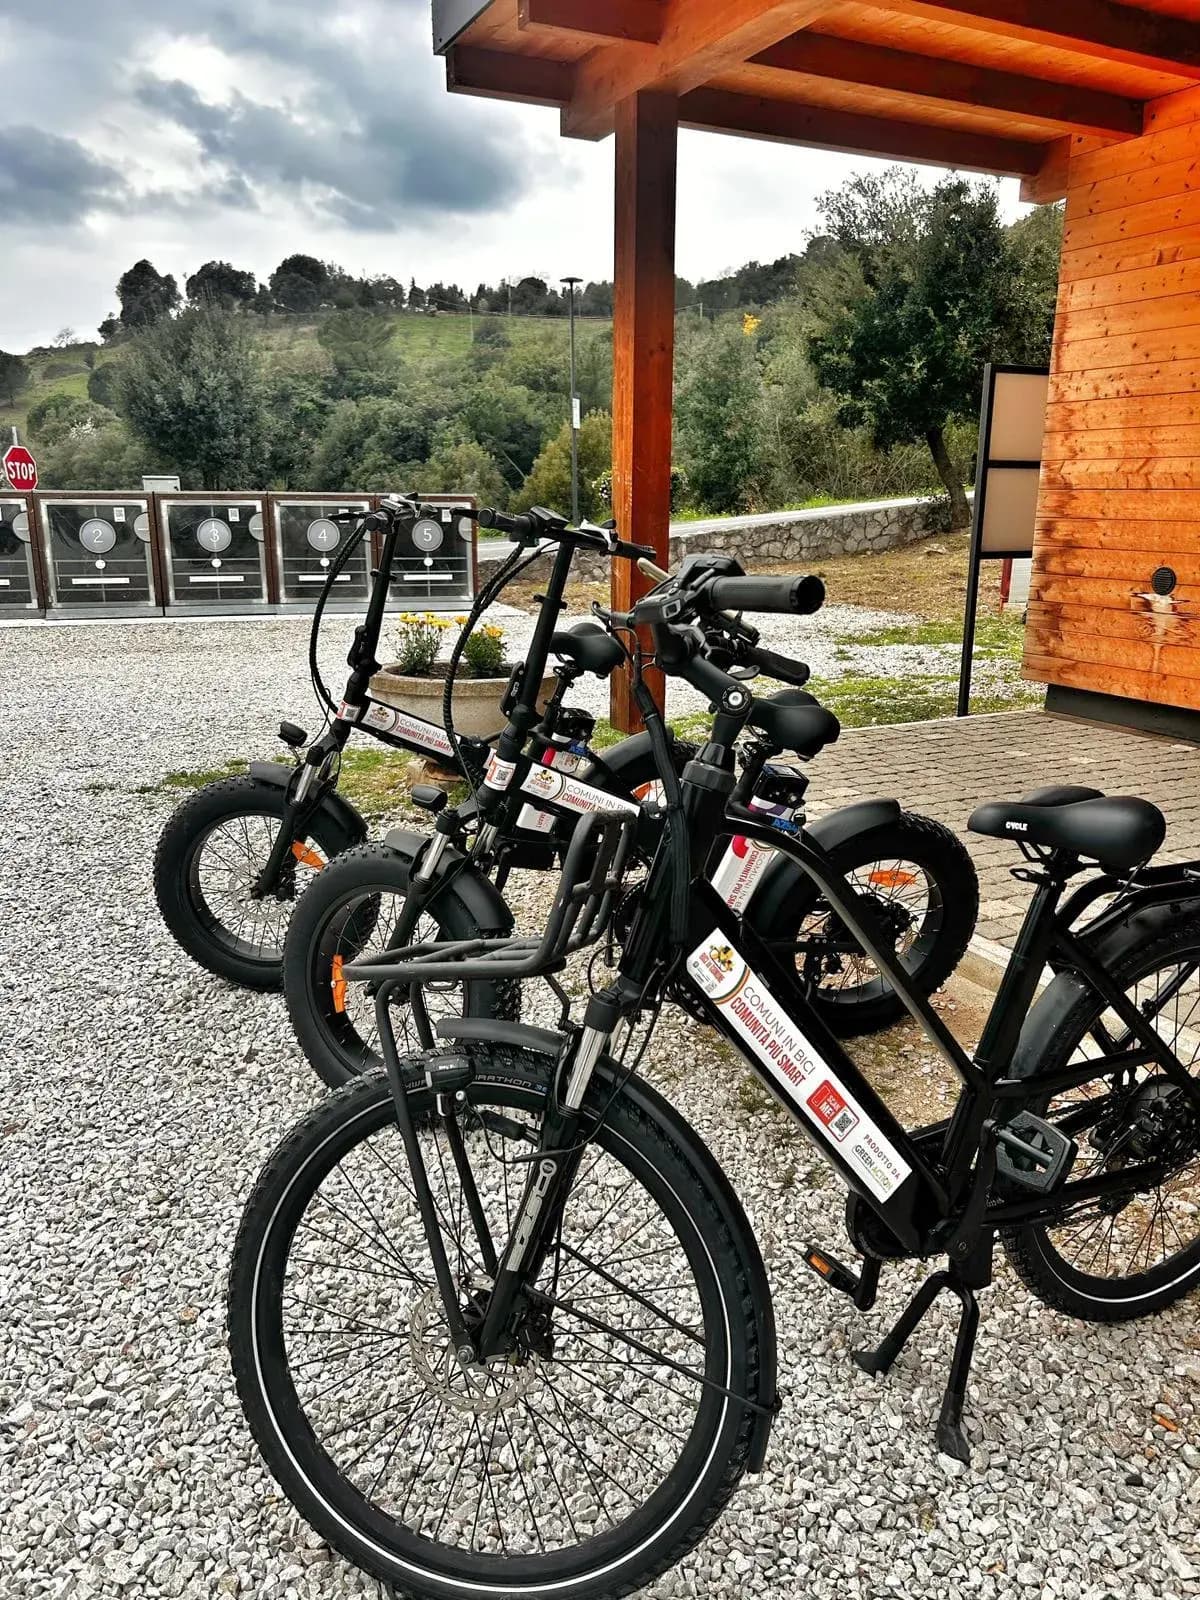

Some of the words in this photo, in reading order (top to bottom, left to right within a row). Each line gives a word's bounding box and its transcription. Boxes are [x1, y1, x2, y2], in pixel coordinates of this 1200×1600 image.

[7, 461, 35, 480] STOP
[92, 528, 104, 543] 2
[209, 528, 220, 543] 3
[318, 528, 328, 542] 4
[423, 528, 432, 542] 5
[399, 718, 431, 735] COMUNI
[566, 784, 605, 804] COMUNI
[605, 799, 616, 809] IN
[1005, 821, 1028, 831] CYCLE
[743, 986, 786, 1038] COMUNI
[782, 1035, 797, 1052] IN
[793, 1048, 816, 1075] BICI
[730, 997, 772, 1046] COMUNITÀ
[765, 1039, 784, 1059] PIÙ
[777, 1054, 806, 1087] SMART
[818, 1101, 834, 1119] ME!
[826, 1095, 841, 1112] SCAN
[855, 1144, 875, 1168] GREEN
[863, 1134, 893, 1169] PRODOTTO
[891, 1167, 901, 1180] DA
